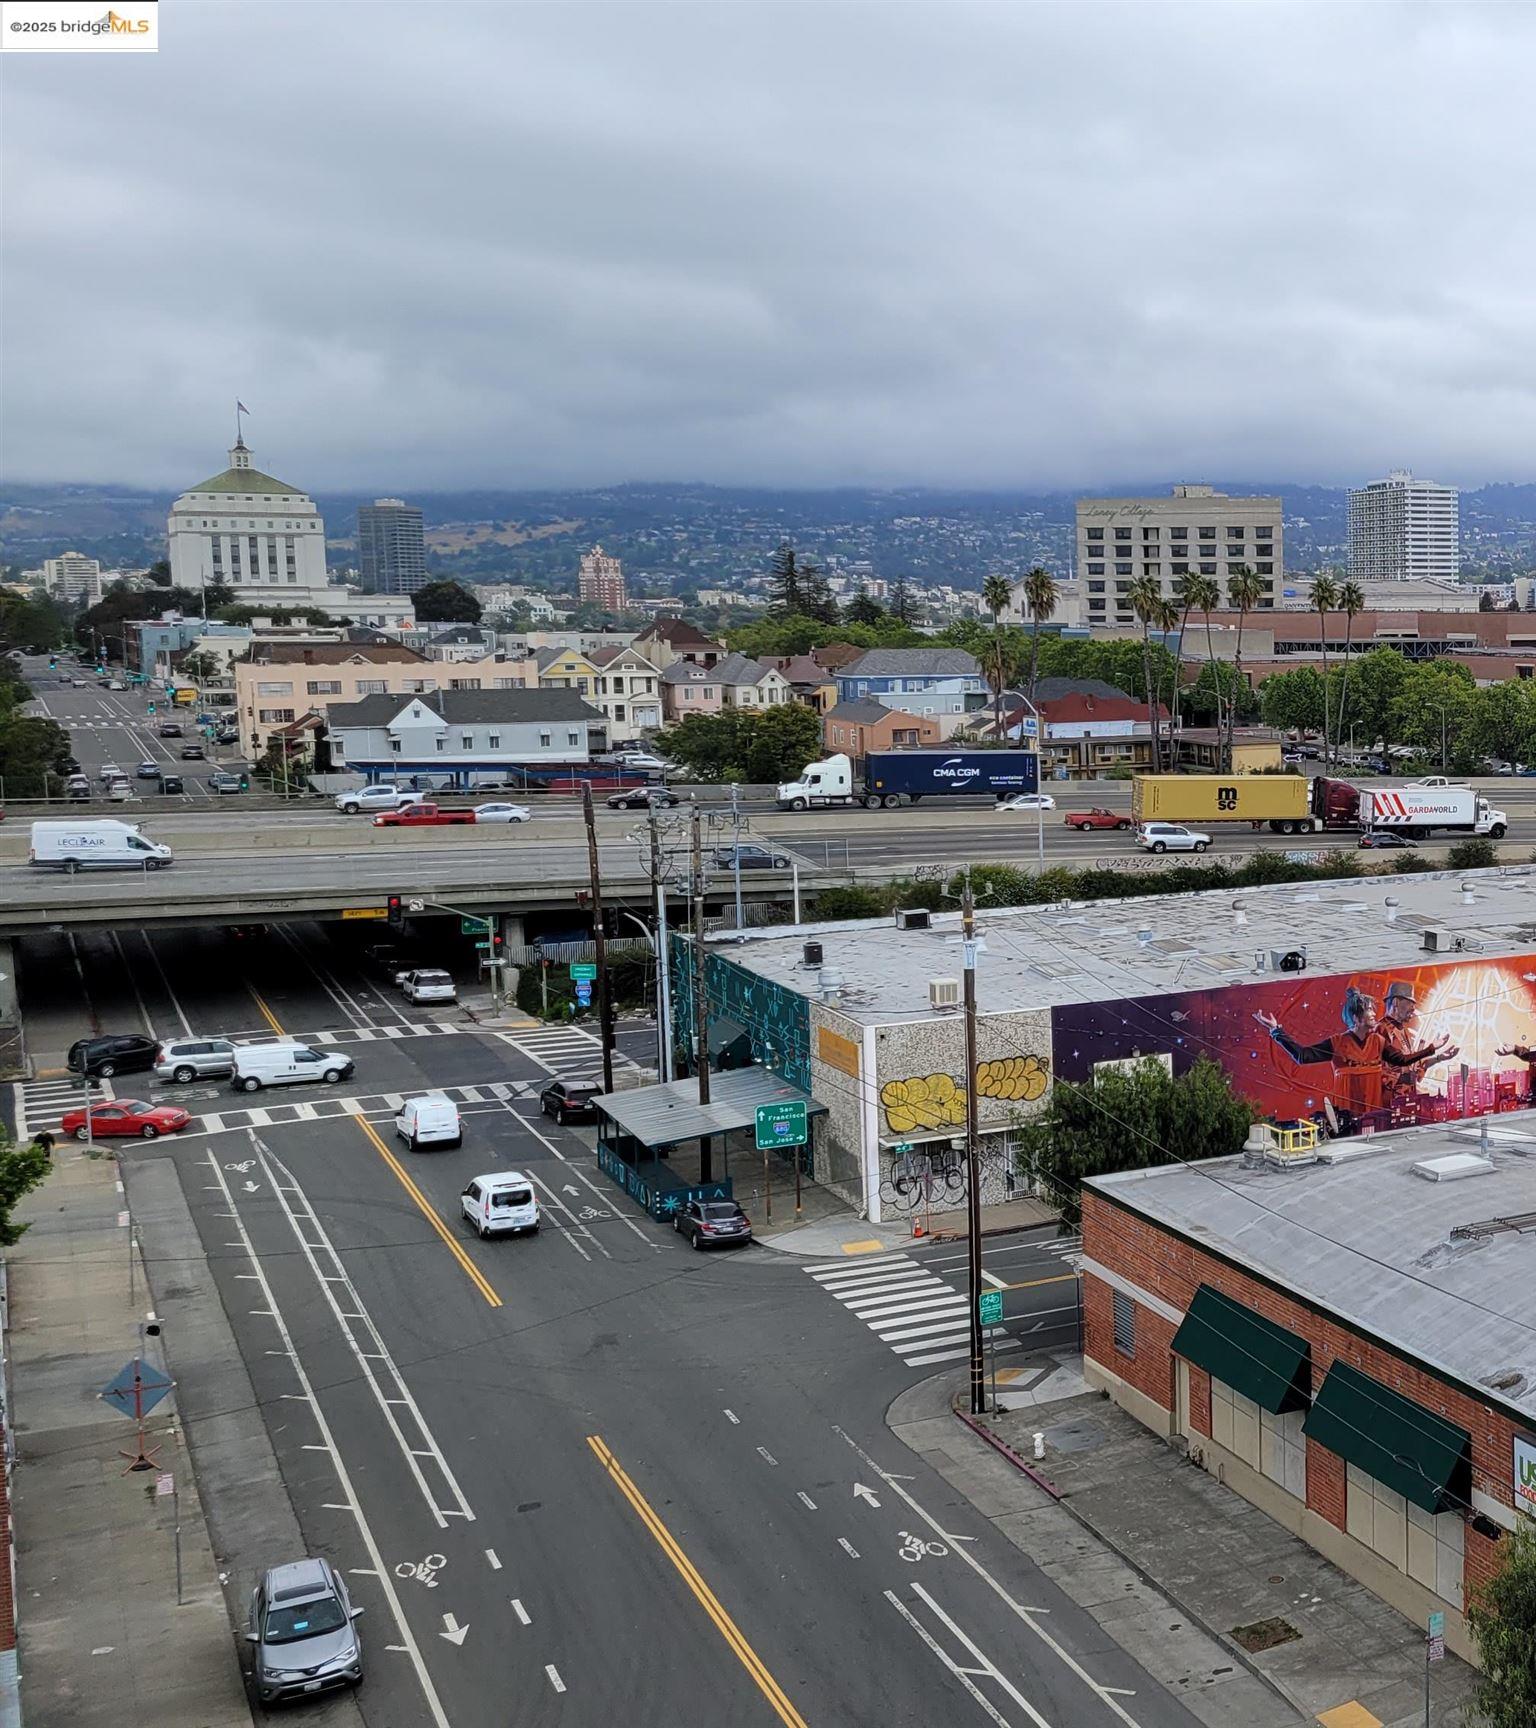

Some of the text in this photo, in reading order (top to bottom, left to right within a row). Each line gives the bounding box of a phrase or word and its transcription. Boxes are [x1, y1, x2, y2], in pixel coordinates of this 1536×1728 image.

[933, 768, 980, 777] CMA CGM
[1408, 806, 1458, 814] GARDAWORLD
[768, 1113, 805, 1121] Francisco
[776, 1136, 794, 1144] Jose
